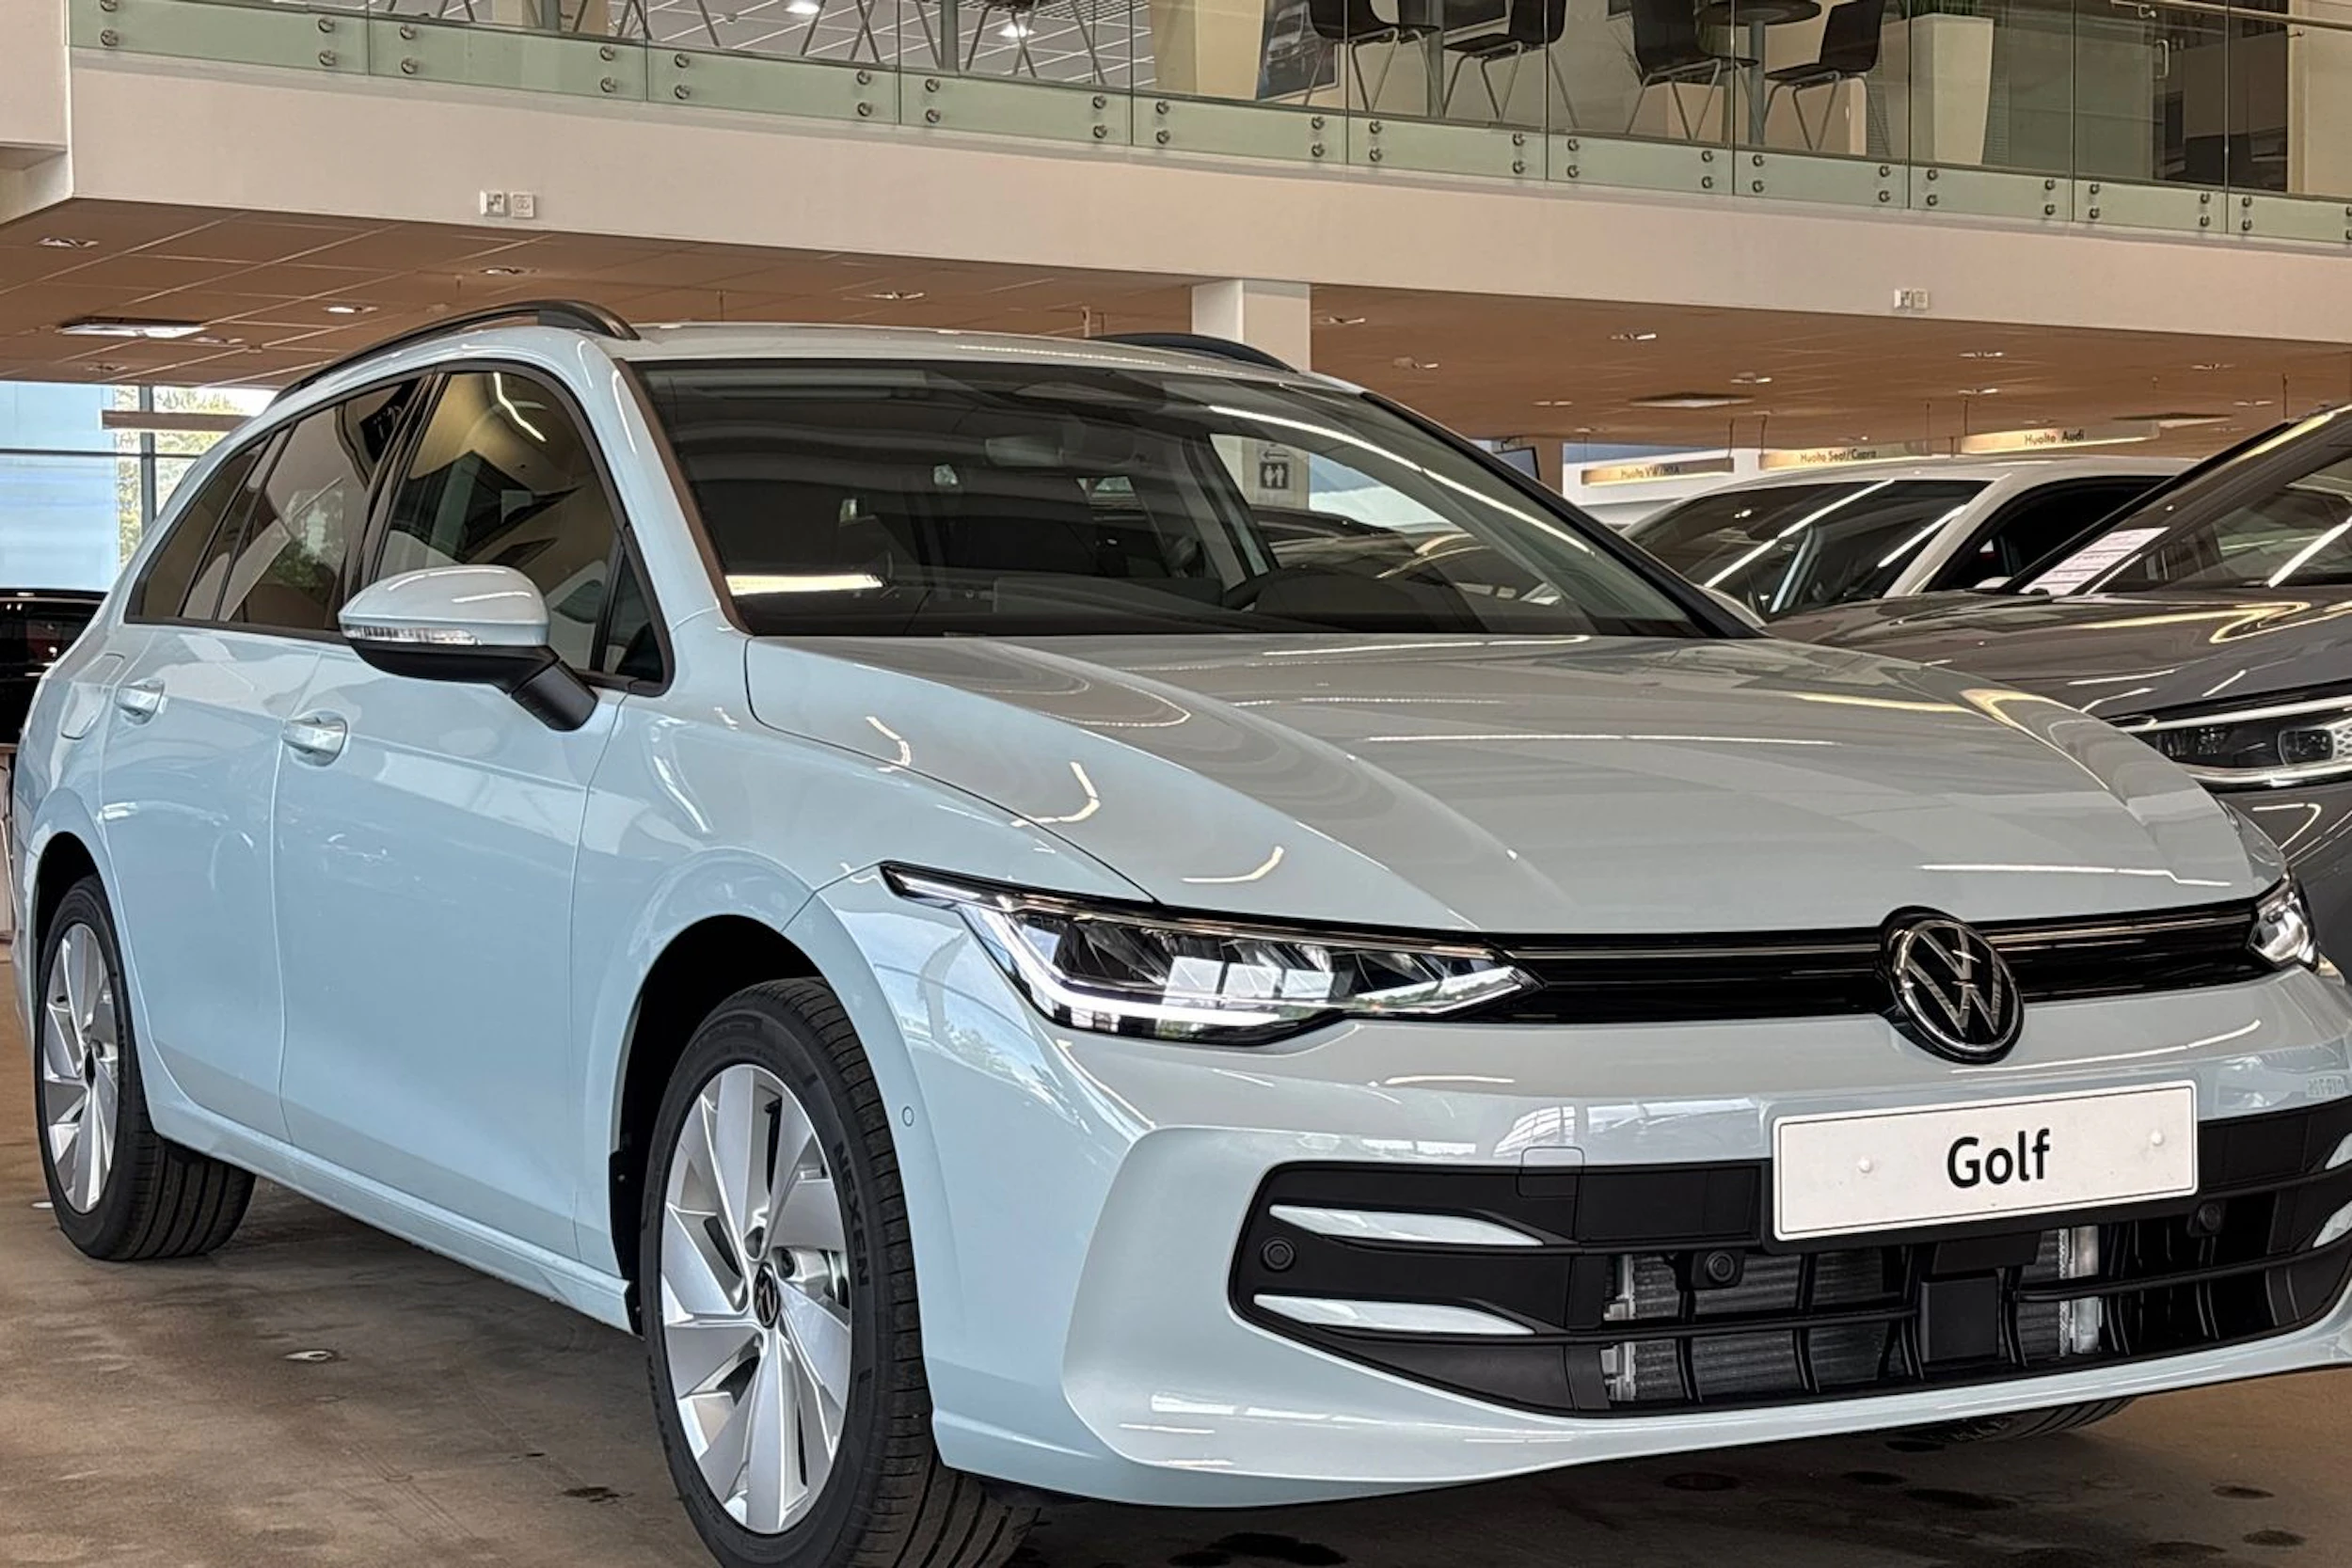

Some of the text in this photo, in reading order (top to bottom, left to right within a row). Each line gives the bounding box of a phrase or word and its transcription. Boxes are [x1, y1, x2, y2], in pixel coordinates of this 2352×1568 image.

[2025, 429, 2085, 446] Huolto Audi
[1947, 1128, 2050, 1189] Golf
[833, 1140, 870, 1287] NEXEN
